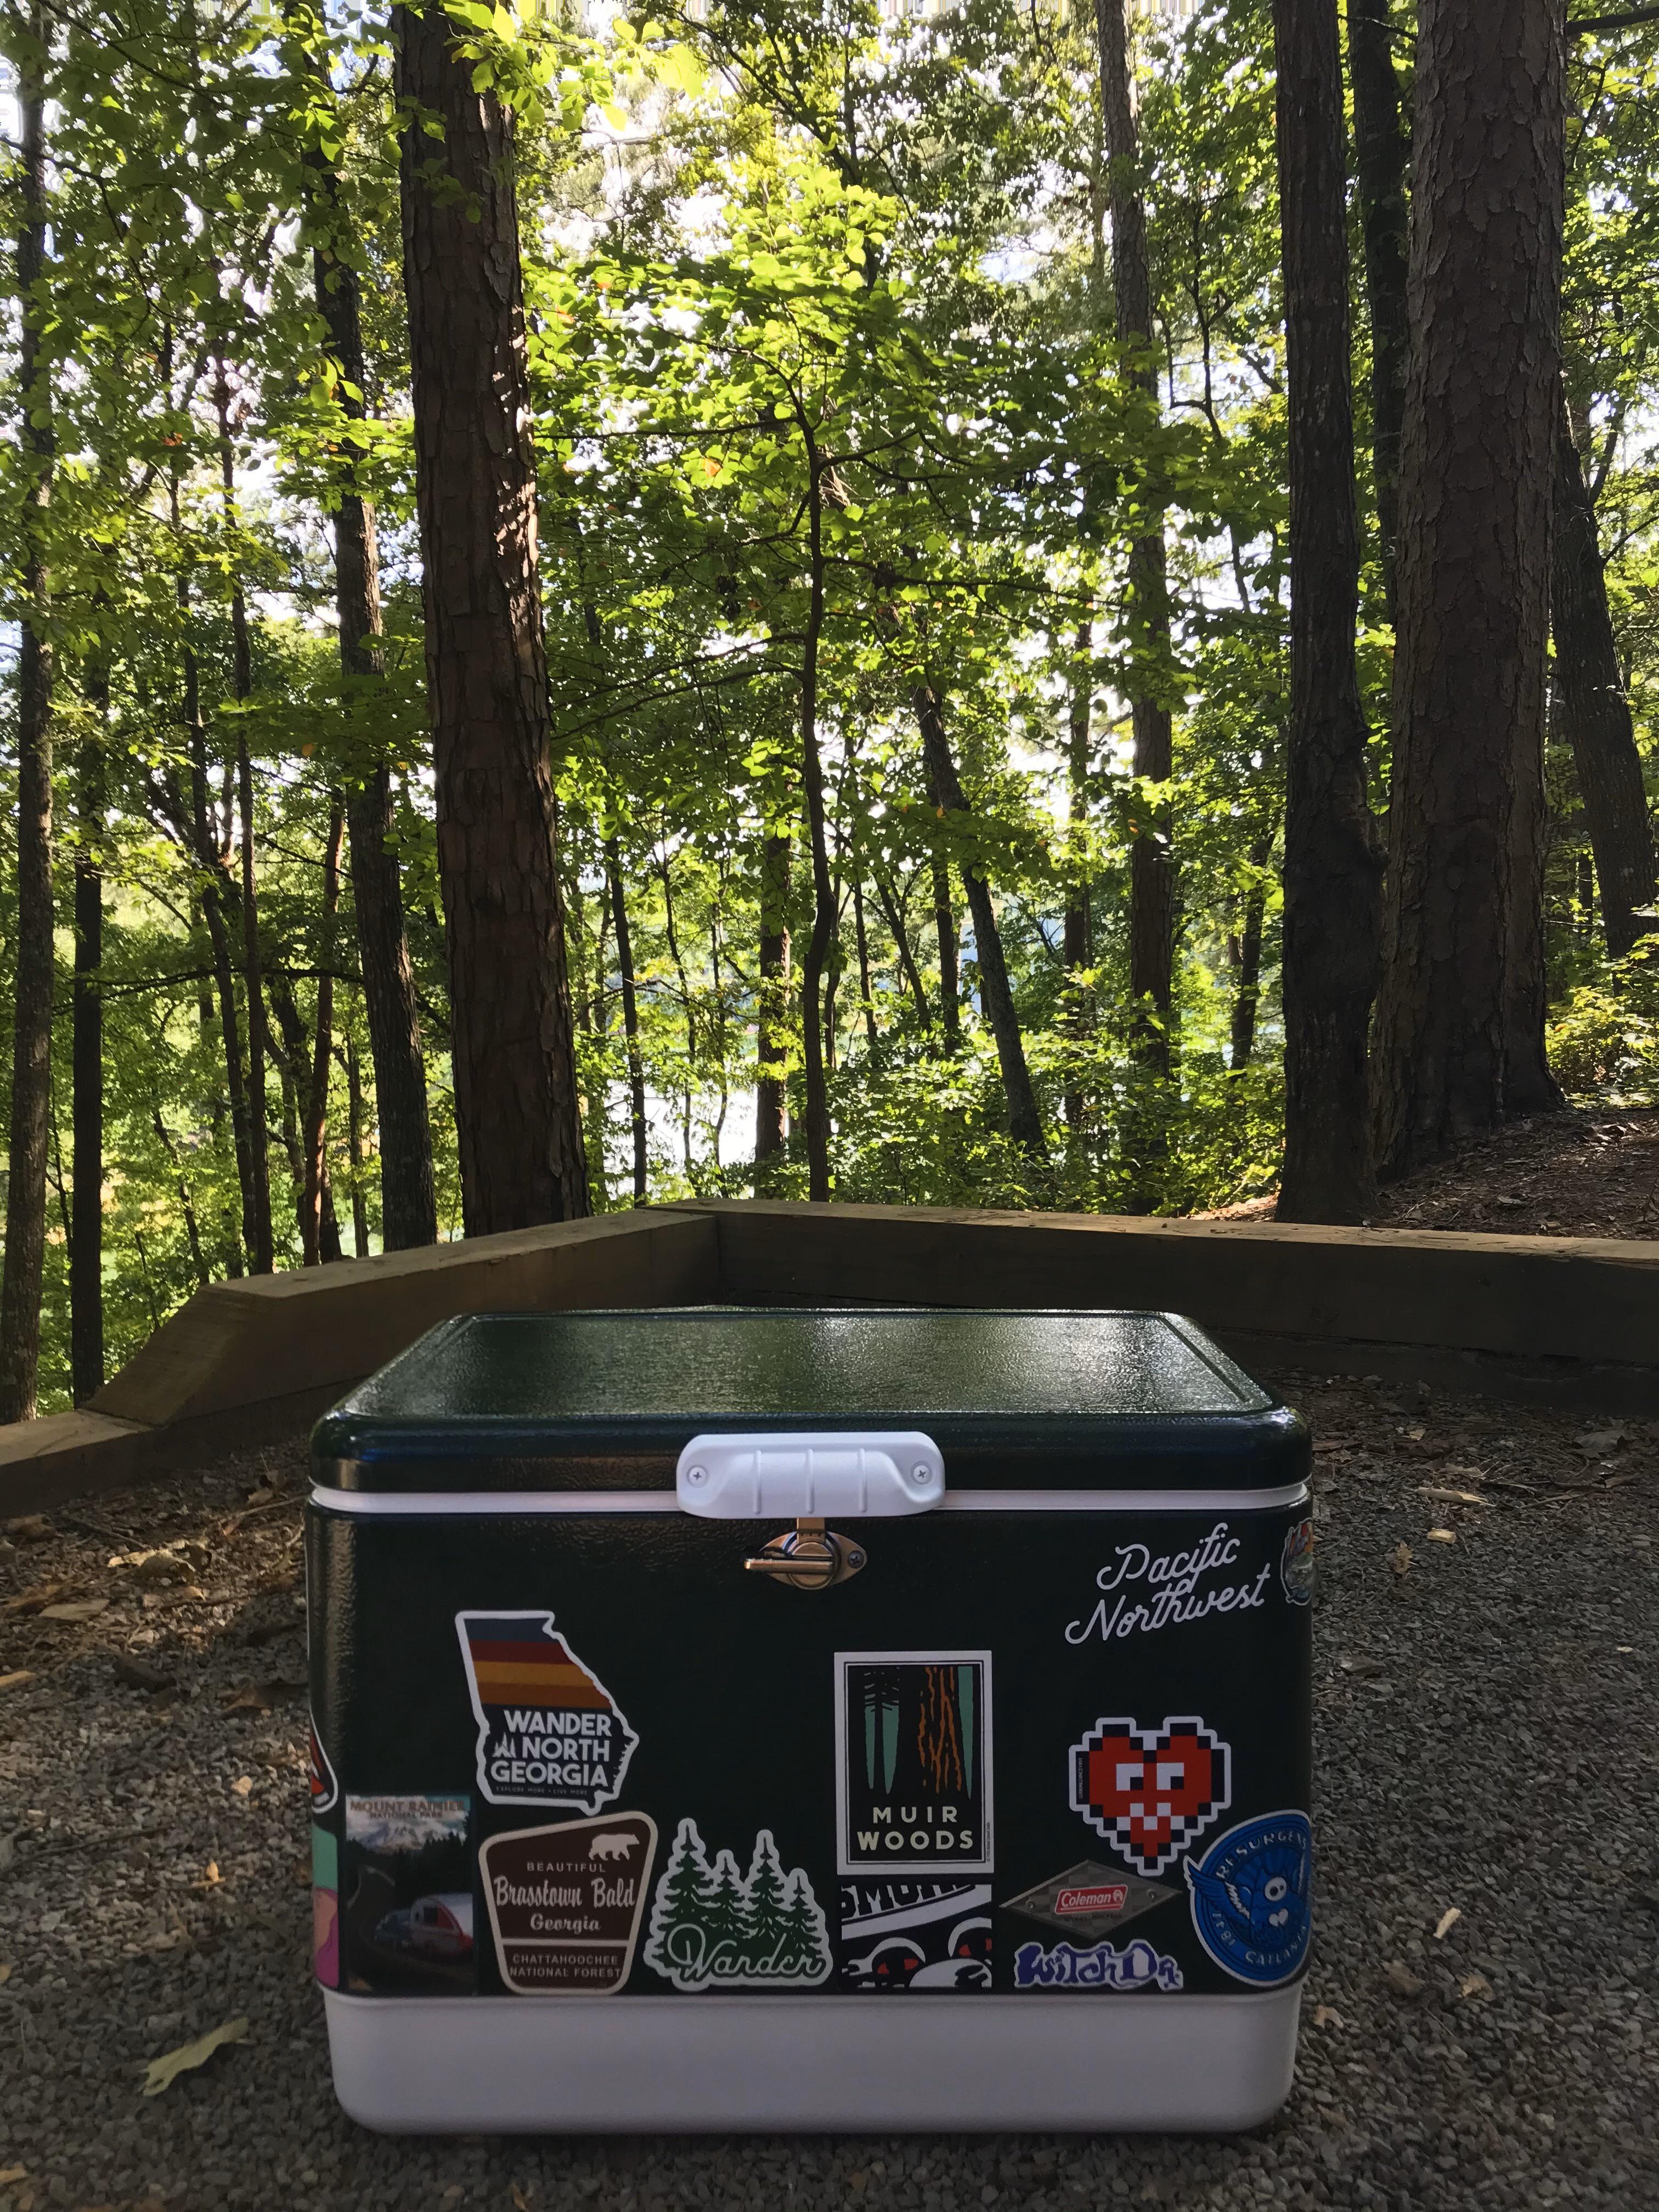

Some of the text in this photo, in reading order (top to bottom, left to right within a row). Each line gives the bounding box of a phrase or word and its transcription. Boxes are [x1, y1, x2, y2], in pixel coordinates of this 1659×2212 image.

[1097, 1522, 1240, 1594] Pacific
[1065, 1563, 1271, 1644] Northwest
[503, 1709, 612, 1737] WANDER
[522, 1736, 610, 1762] NORTH
[490, 1760, 608, 1787] GEORGIA
[350, 1801, 404, 1811] MOUNT
[873, 1806, 957, 1824] MUIR
[856, 1830, 973, 1851] WOODS
[526, 1861, 606, 1873] BEAUTIFUL
[494, 1875, 635, 1908] Brasstown Bald
[1061, 1892, 1112, 1908] Coleman
[531, 1913, 601, 1935] Georgia
[512, 1953, 618, 1966] CHATTAHOOCHEE
[668, 1923, 823, 1978] Wander
[510, 1966, 622, 1978] NATIONAL FOREST
